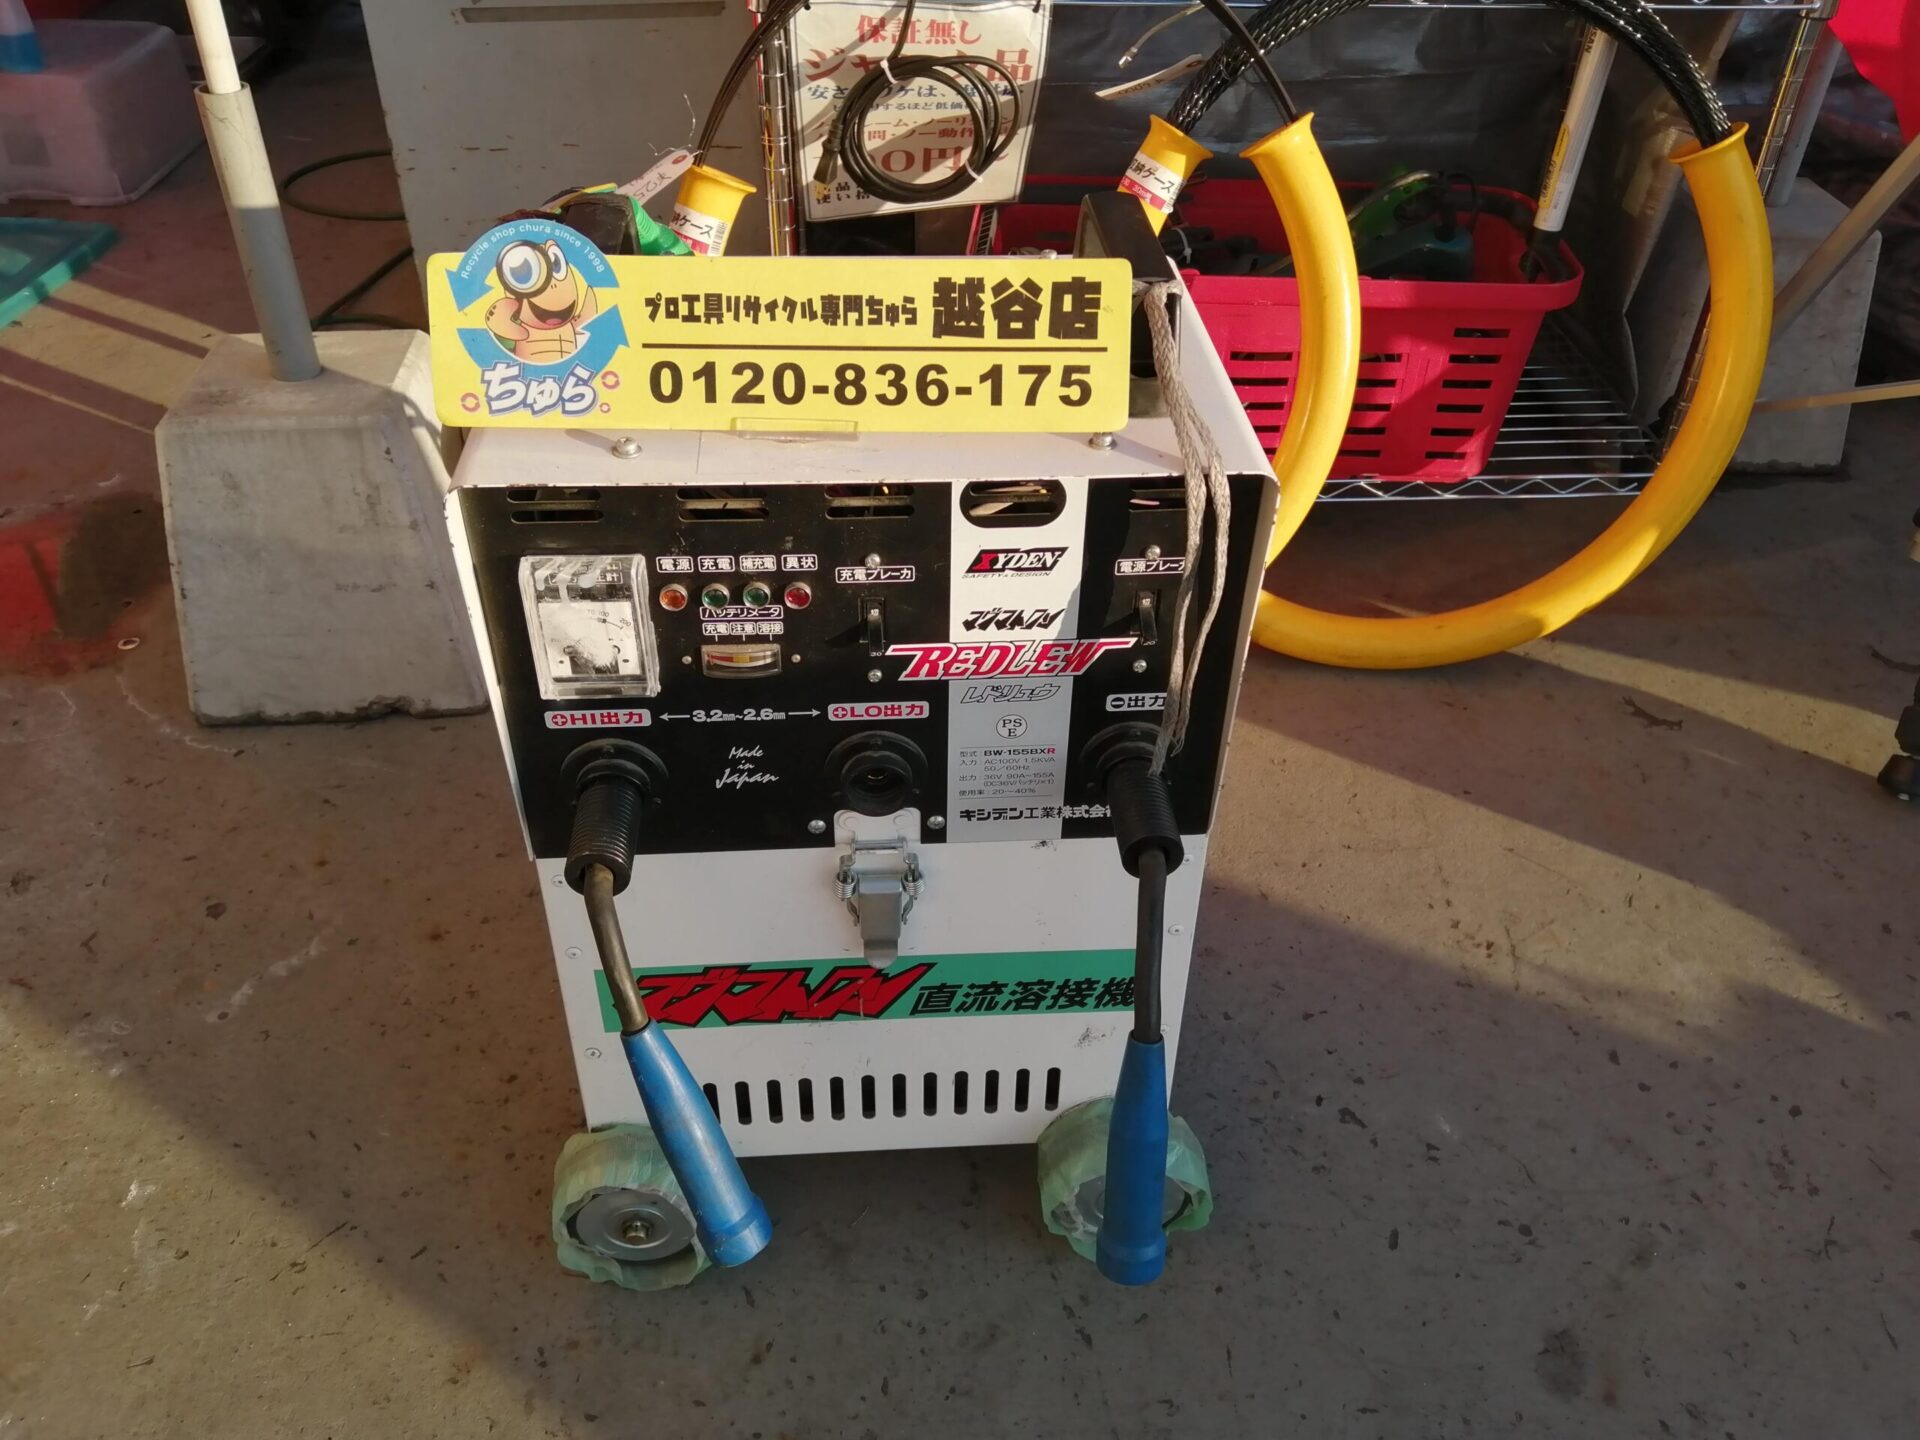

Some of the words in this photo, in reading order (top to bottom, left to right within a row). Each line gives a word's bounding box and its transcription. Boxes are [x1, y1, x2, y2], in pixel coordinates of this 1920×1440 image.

[856, 15, 981, 45] 保証無し
[461, 242, 490, 279] Recycle
[491, 226, 516, 243] shop
[519, 223, 550, 233] chura
[554, 228, 581, 248] since
[584, 247, 605, 273] 1998
[644, 292, 917, 327] プロ工具リサイクル専門ちゅら
[932, 276, 1102, 340] 越谷店
[481, 361, 597, 416] ちゅら
[650, 360, 1092, 407] 0120-836-175
[660, 558, 691, 571] 電源
[701, 557, 732, 570] 充電
[785, 555, 815, 569] 異状
[840, 568, 912, 581] 充電ブレーカ
[705, 623, 728, 634] 充電
[960, 684, 1060, 704] レドリュウ
[729, 744, 764, 759] Made
[984, 748, 1056, 757] BW-155BXR
[737, 760, 755, 771] in
[716, 768, 779, 789] Japan
[909, 976, 1135, 1016] 直流溶接機
